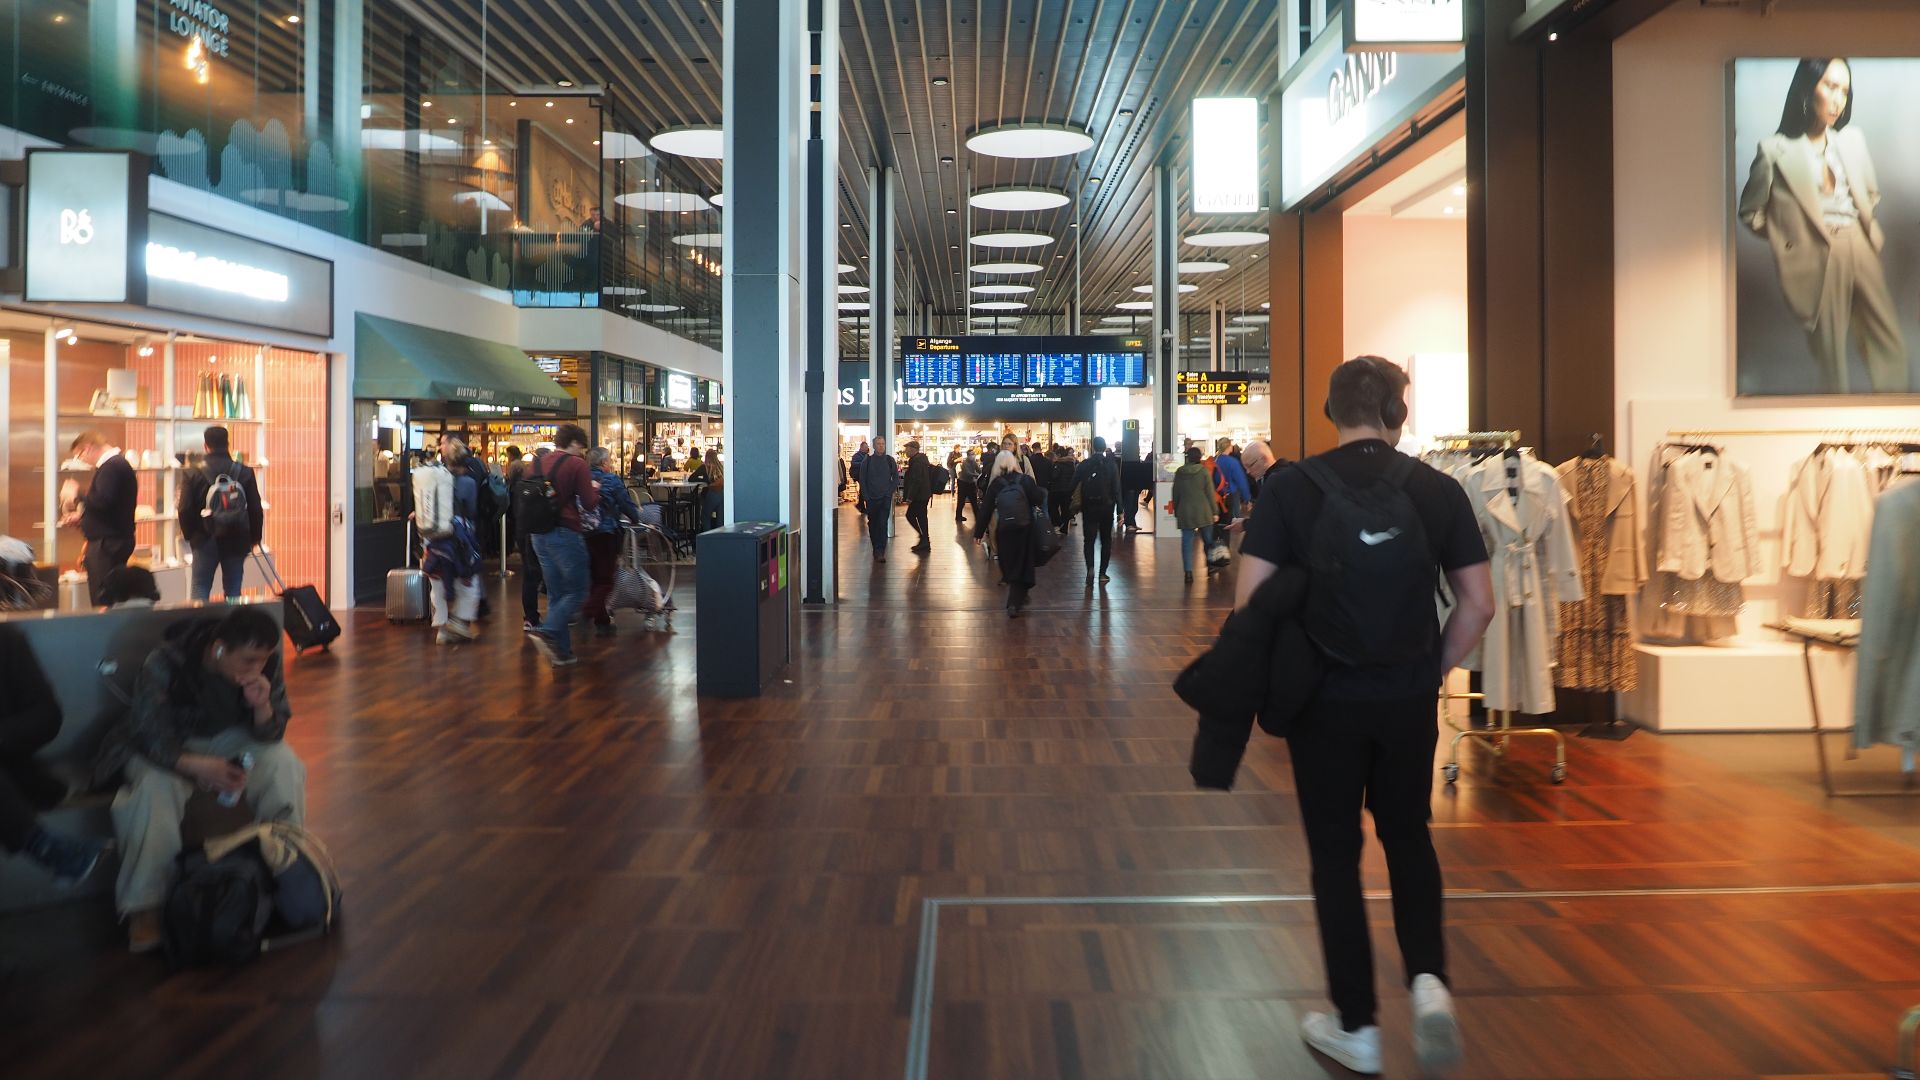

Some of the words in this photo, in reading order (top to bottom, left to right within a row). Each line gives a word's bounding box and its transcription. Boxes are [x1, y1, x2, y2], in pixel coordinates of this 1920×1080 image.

[170, 11, 229, 58] LOUNGE
[1200, 372, 1208, 382] A
[456, 387, 477, 398] BISTRO
